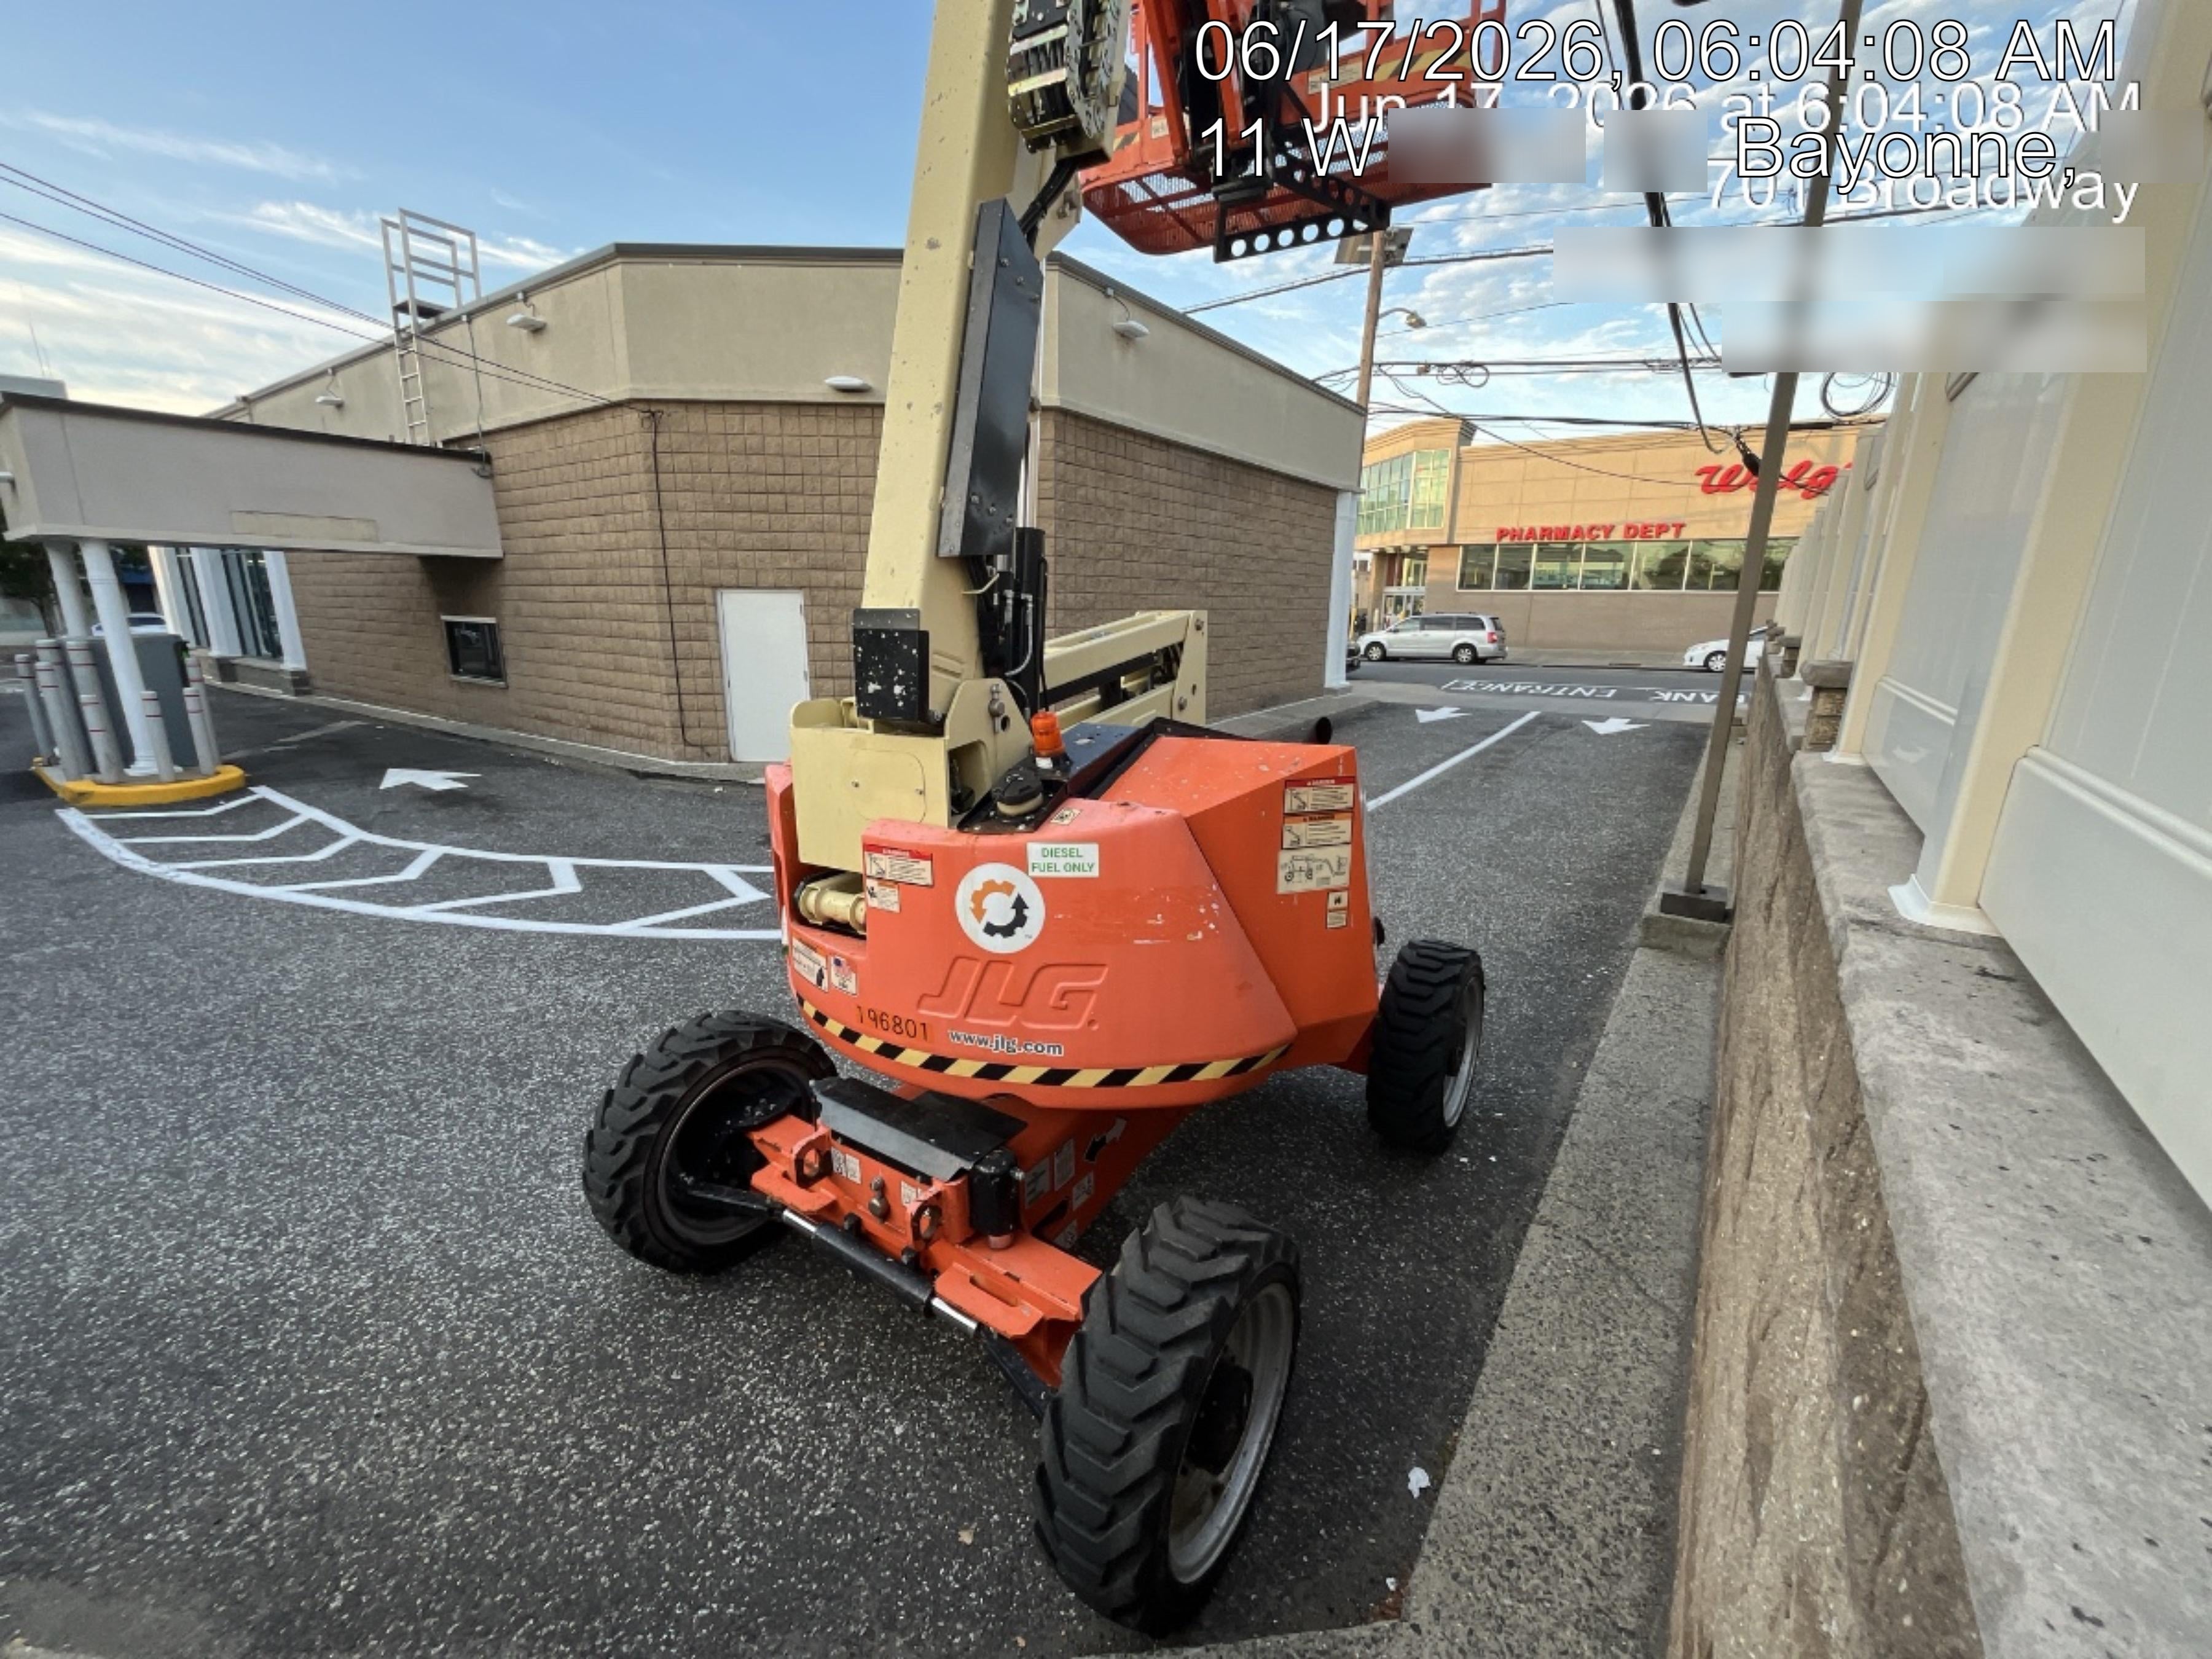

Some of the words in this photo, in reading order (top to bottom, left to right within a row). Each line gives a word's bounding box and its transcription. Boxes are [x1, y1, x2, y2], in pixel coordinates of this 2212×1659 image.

[1496, 524, 1615, 541] PHARMACY
[1622, 522, 1686, 539] DEPT
[1041, 847, 1083, 858] DIESEL
[1032, 863, 1061, 873] FUEL
[1064, 863, 1094, 873] ONLY
[856, 1005, 929, 1041] 196801
[949, 1028, 1064, 1056] www.jlg.com
